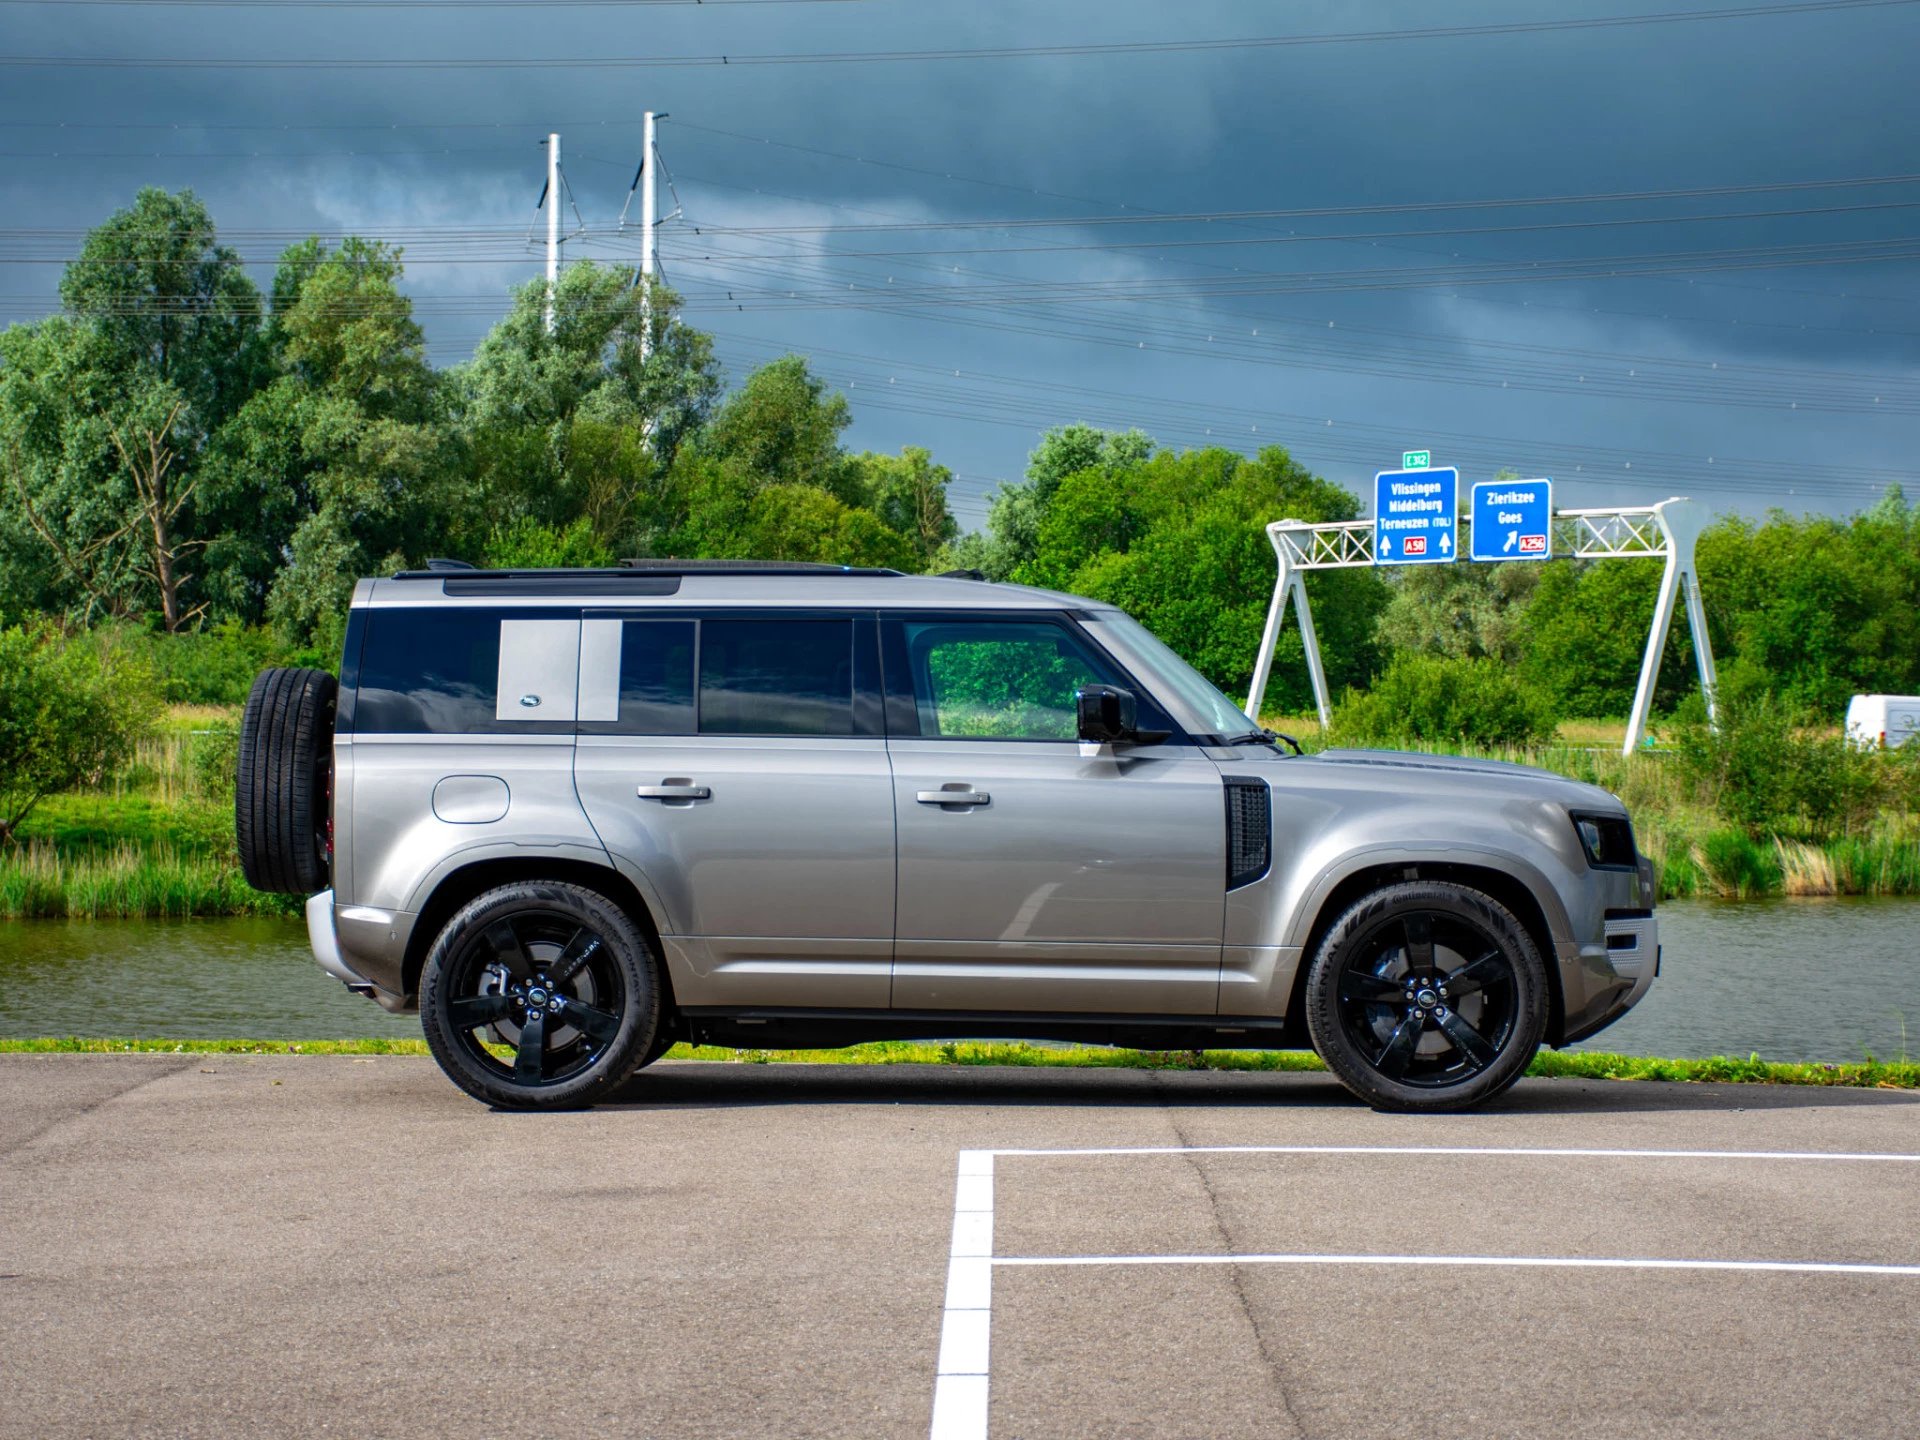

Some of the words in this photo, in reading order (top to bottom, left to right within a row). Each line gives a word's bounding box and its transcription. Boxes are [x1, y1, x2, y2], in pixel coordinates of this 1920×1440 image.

[1391, 482, 1441, 497] Vlissingen
[1486, 491, 1535, 506] Zierikzee
[1389, 499, 1443, 514] Middelburg
[1380, 517, 1429, 530] Terneuzen
[1498, 511, 1523, 525] Goes
